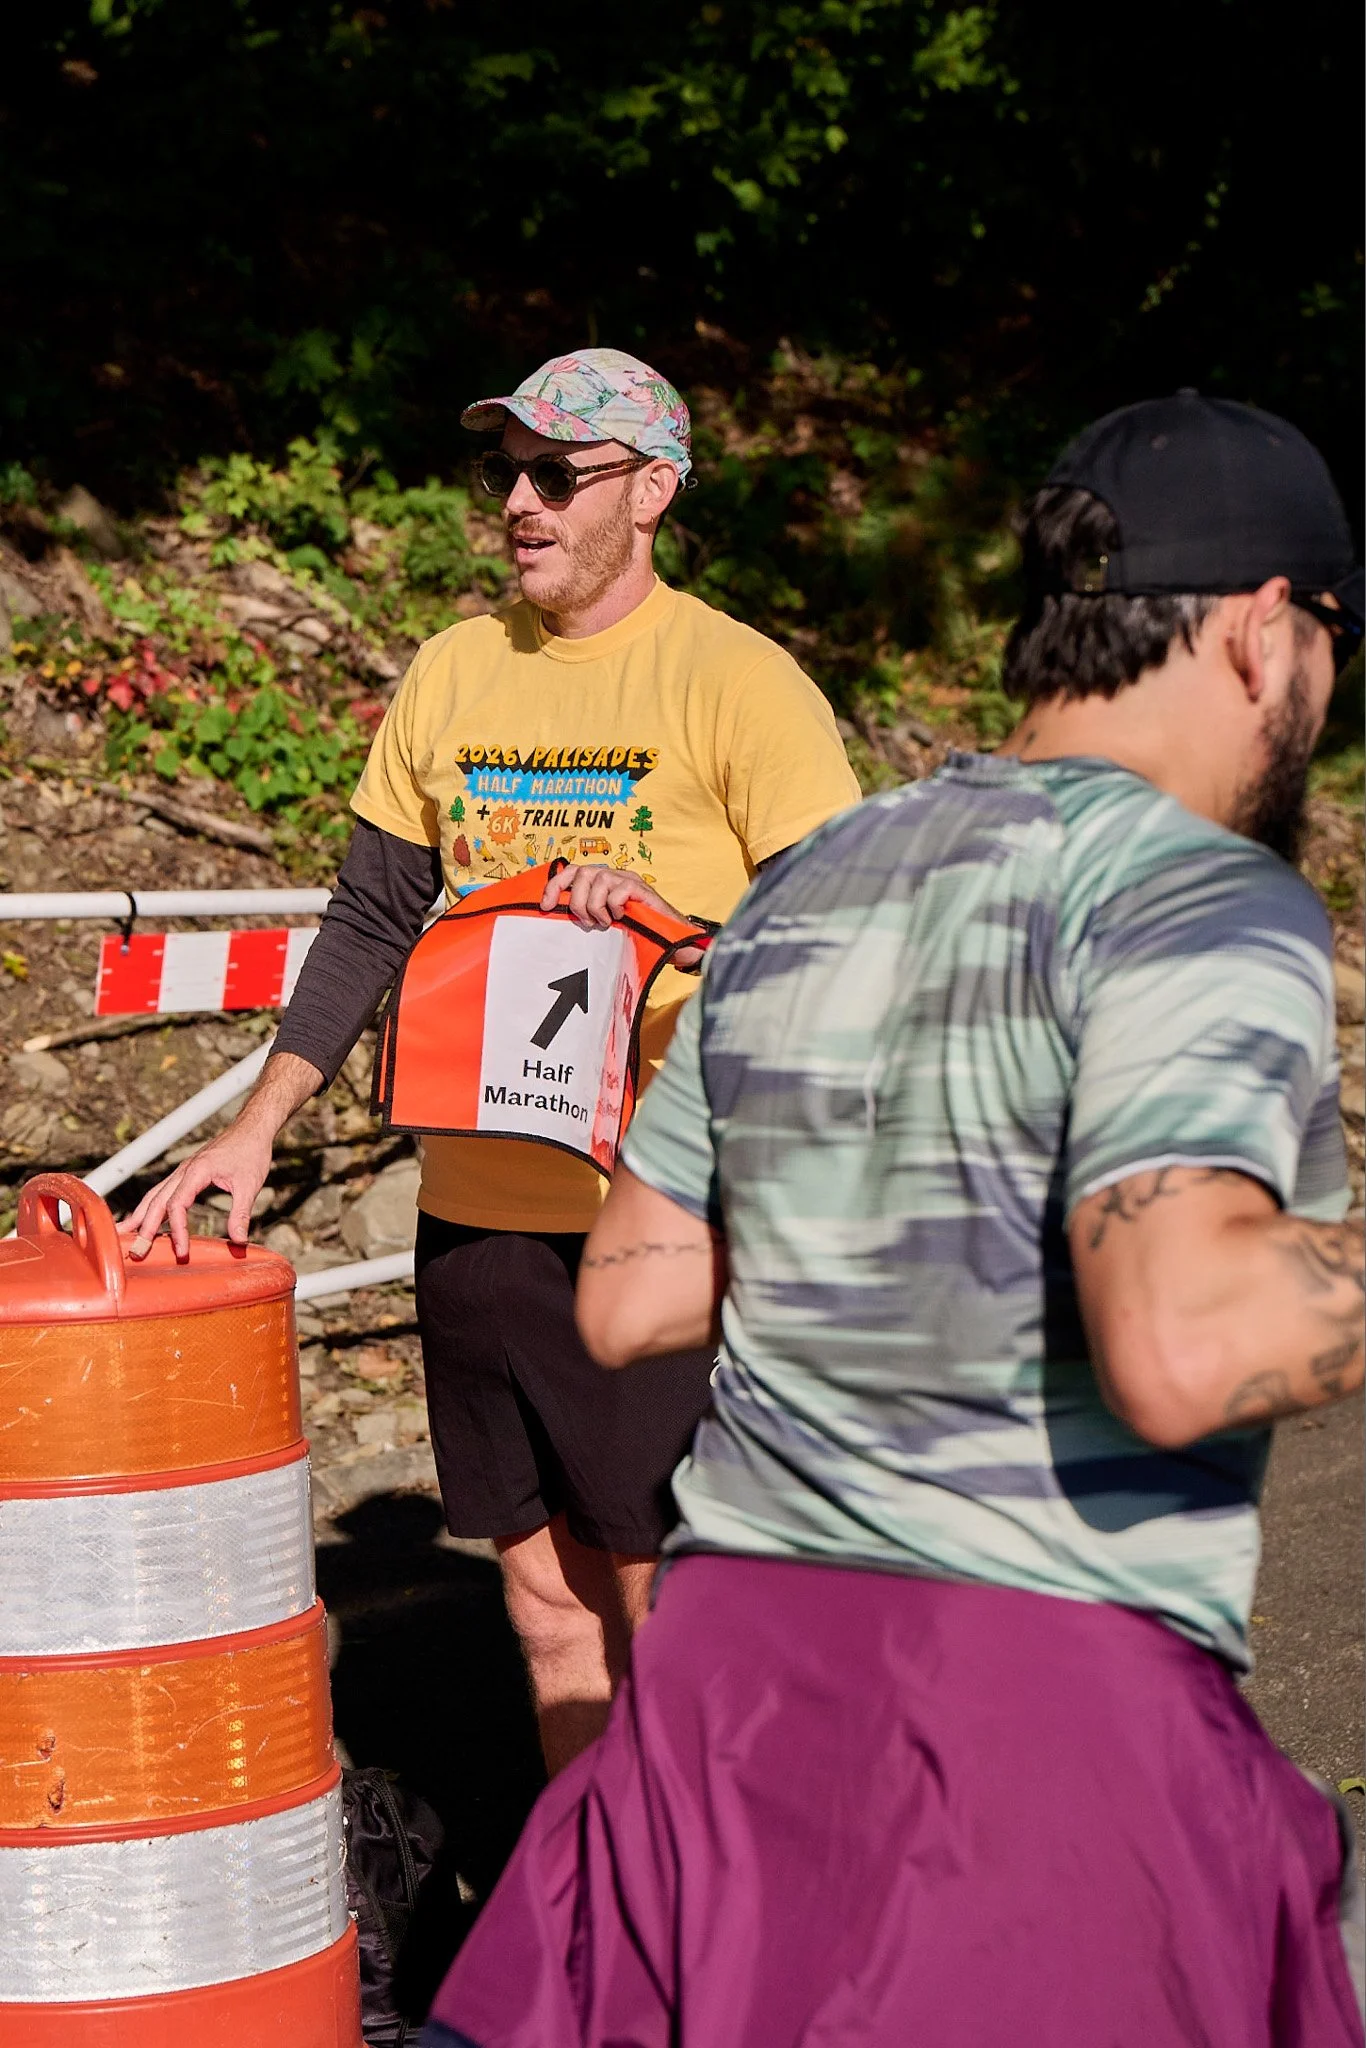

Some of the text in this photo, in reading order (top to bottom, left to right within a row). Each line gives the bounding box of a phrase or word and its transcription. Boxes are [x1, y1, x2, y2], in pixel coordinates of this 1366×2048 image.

[455, 744, 660, 769] 2026 PALISADES
[478, 776, 622, 796] HALF MARATHON
[491, 816, 514, 834] 6K
[522, 809, 569, 828] TRAIL
[574, 809, 614, 829] RUN
[522, 1059, 574, 1085] Half
[484, 1085, 588, 1123] Marathon
